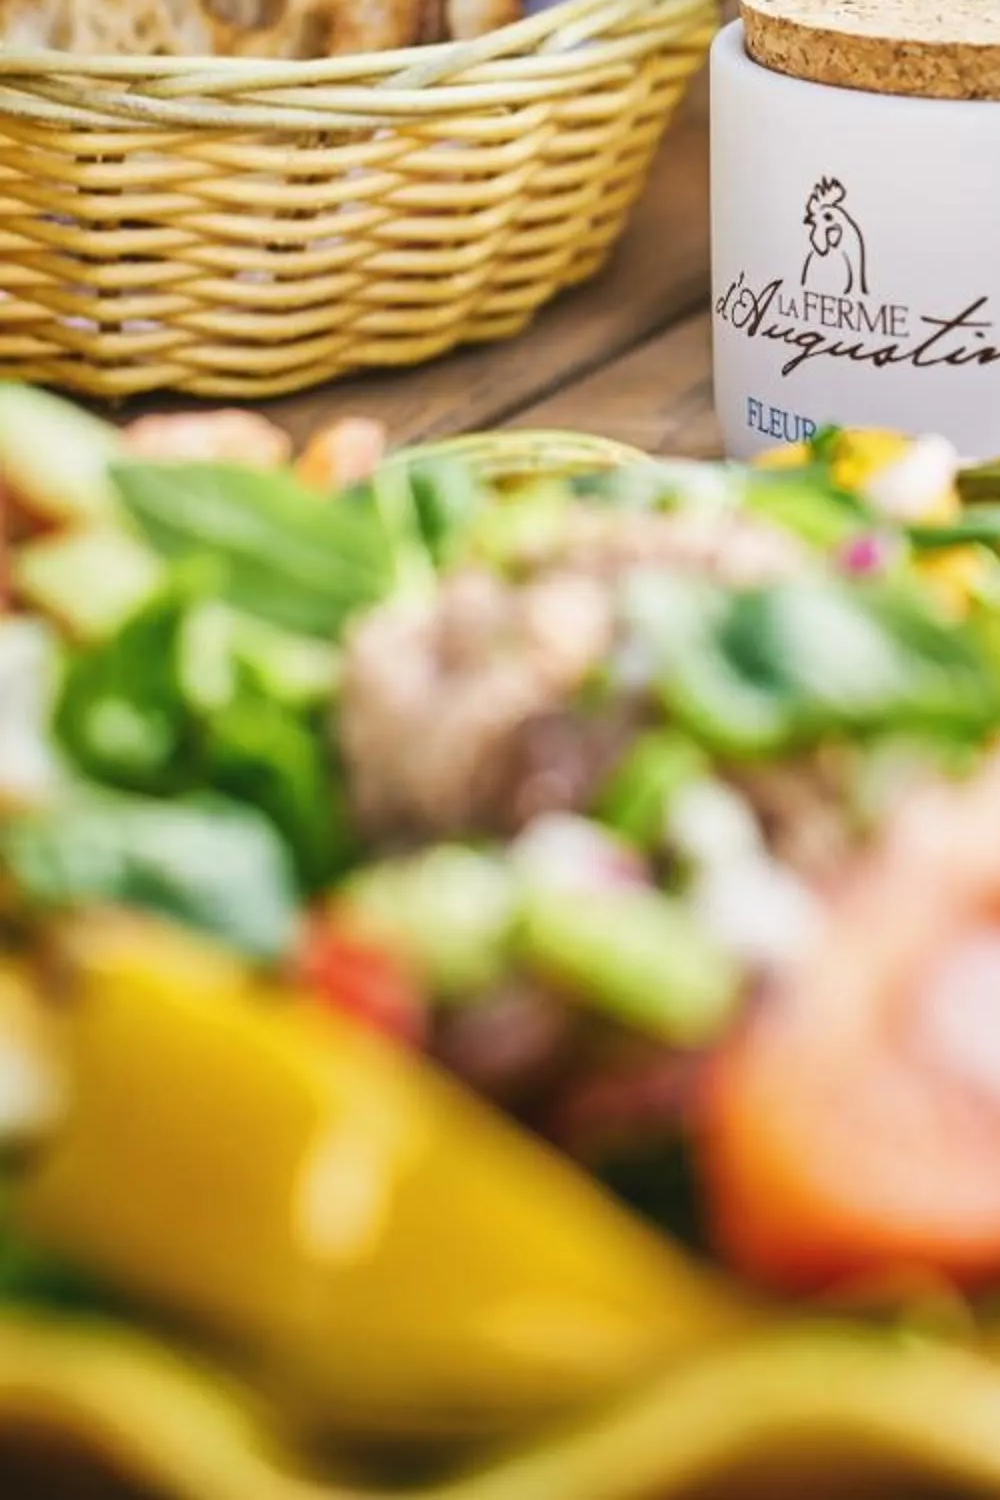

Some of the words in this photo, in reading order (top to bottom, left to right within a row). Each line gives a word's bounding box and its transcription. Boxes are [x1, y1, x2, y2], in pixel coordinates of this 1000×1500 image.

[778, 295, 800, 319] LA
[802, 290, 911, 338] FERME
[746, 396, 818, 444] FLEUR
